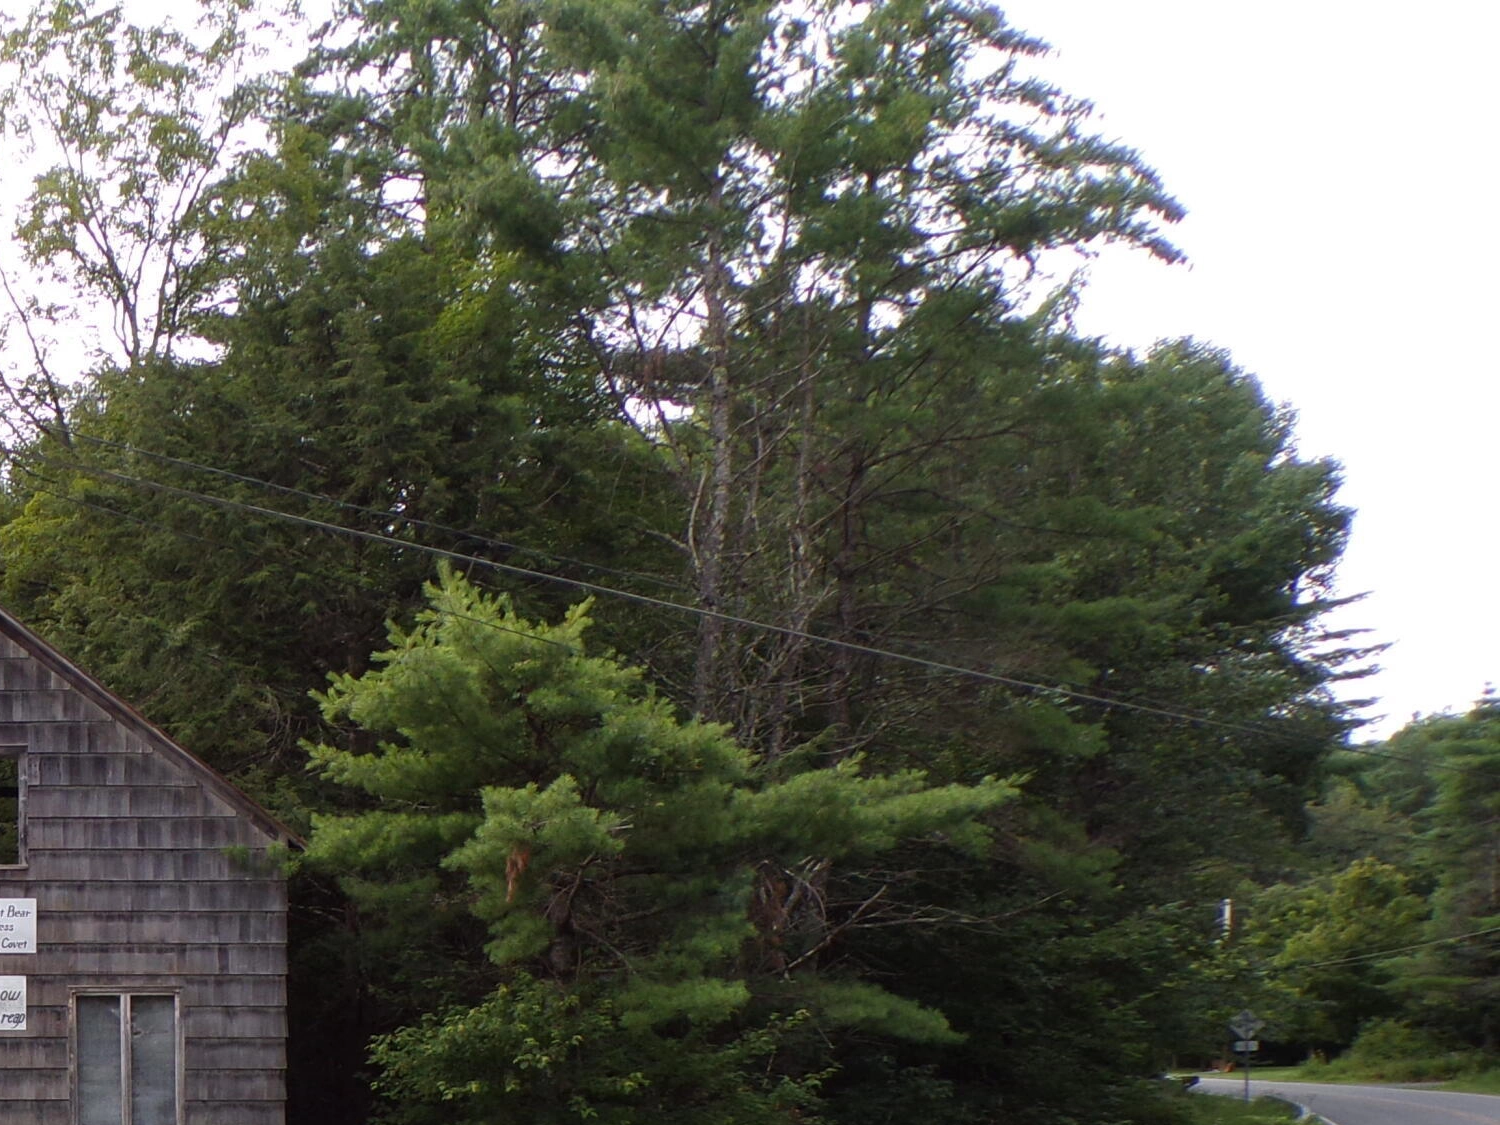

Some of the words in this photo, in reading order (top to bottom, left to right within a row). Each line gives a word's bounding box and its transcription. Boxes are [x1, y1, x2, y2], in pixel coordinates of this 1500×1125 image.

[7, 905, 31, 918] Bear
[1, 937, 28, 949] Covet
[1, 1012, 26, 1028] reap
